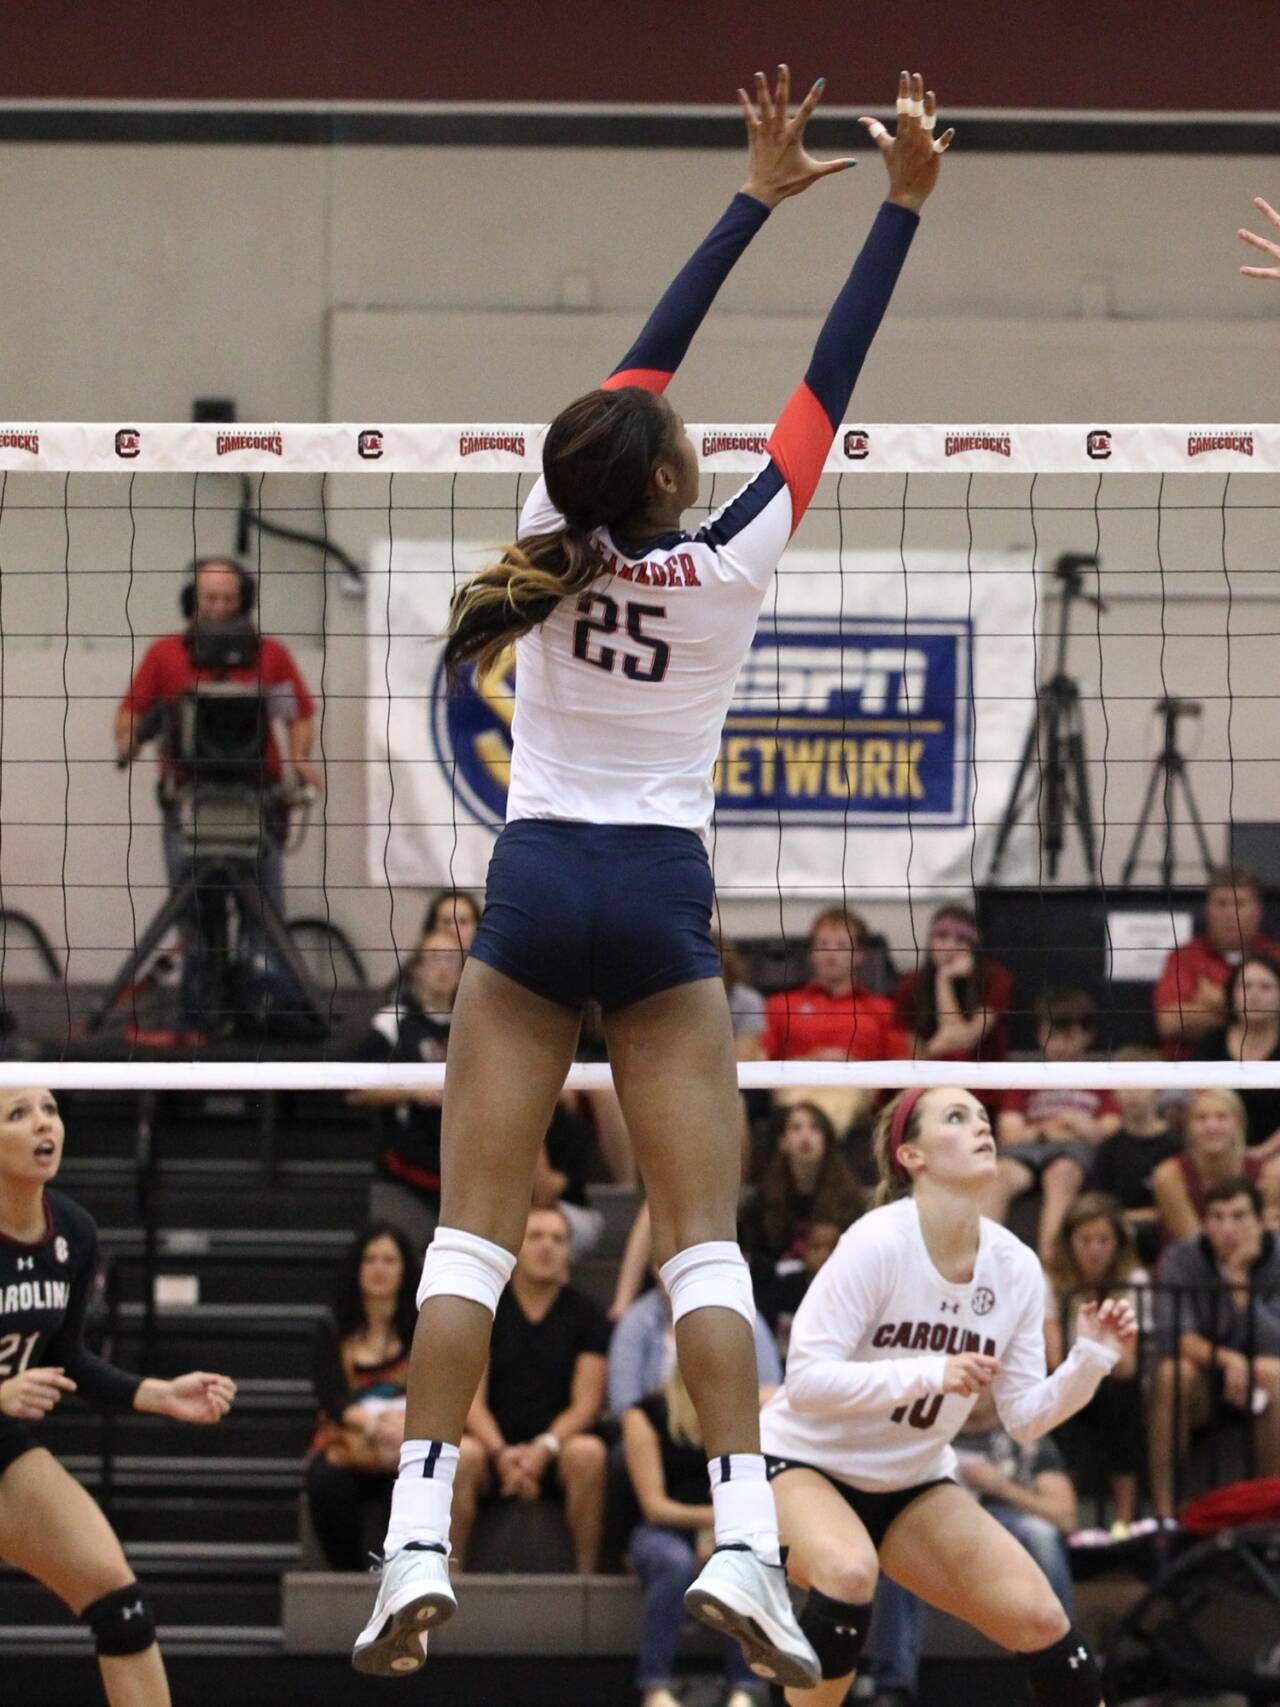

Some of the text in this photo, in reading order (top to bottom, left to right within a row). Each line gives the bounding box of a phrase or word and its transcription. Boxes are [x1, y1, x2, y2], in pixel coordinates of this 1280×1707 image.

[216, 436, 283, 456] GAMECOCKS
[459, 437, 526, 457] GAMECOCKS
[944, 437, 1011, 457] GAMECOCKS
[1187, 437, 1254, 457] GAMECOCKS
[573, 591, 672, 682] 25
